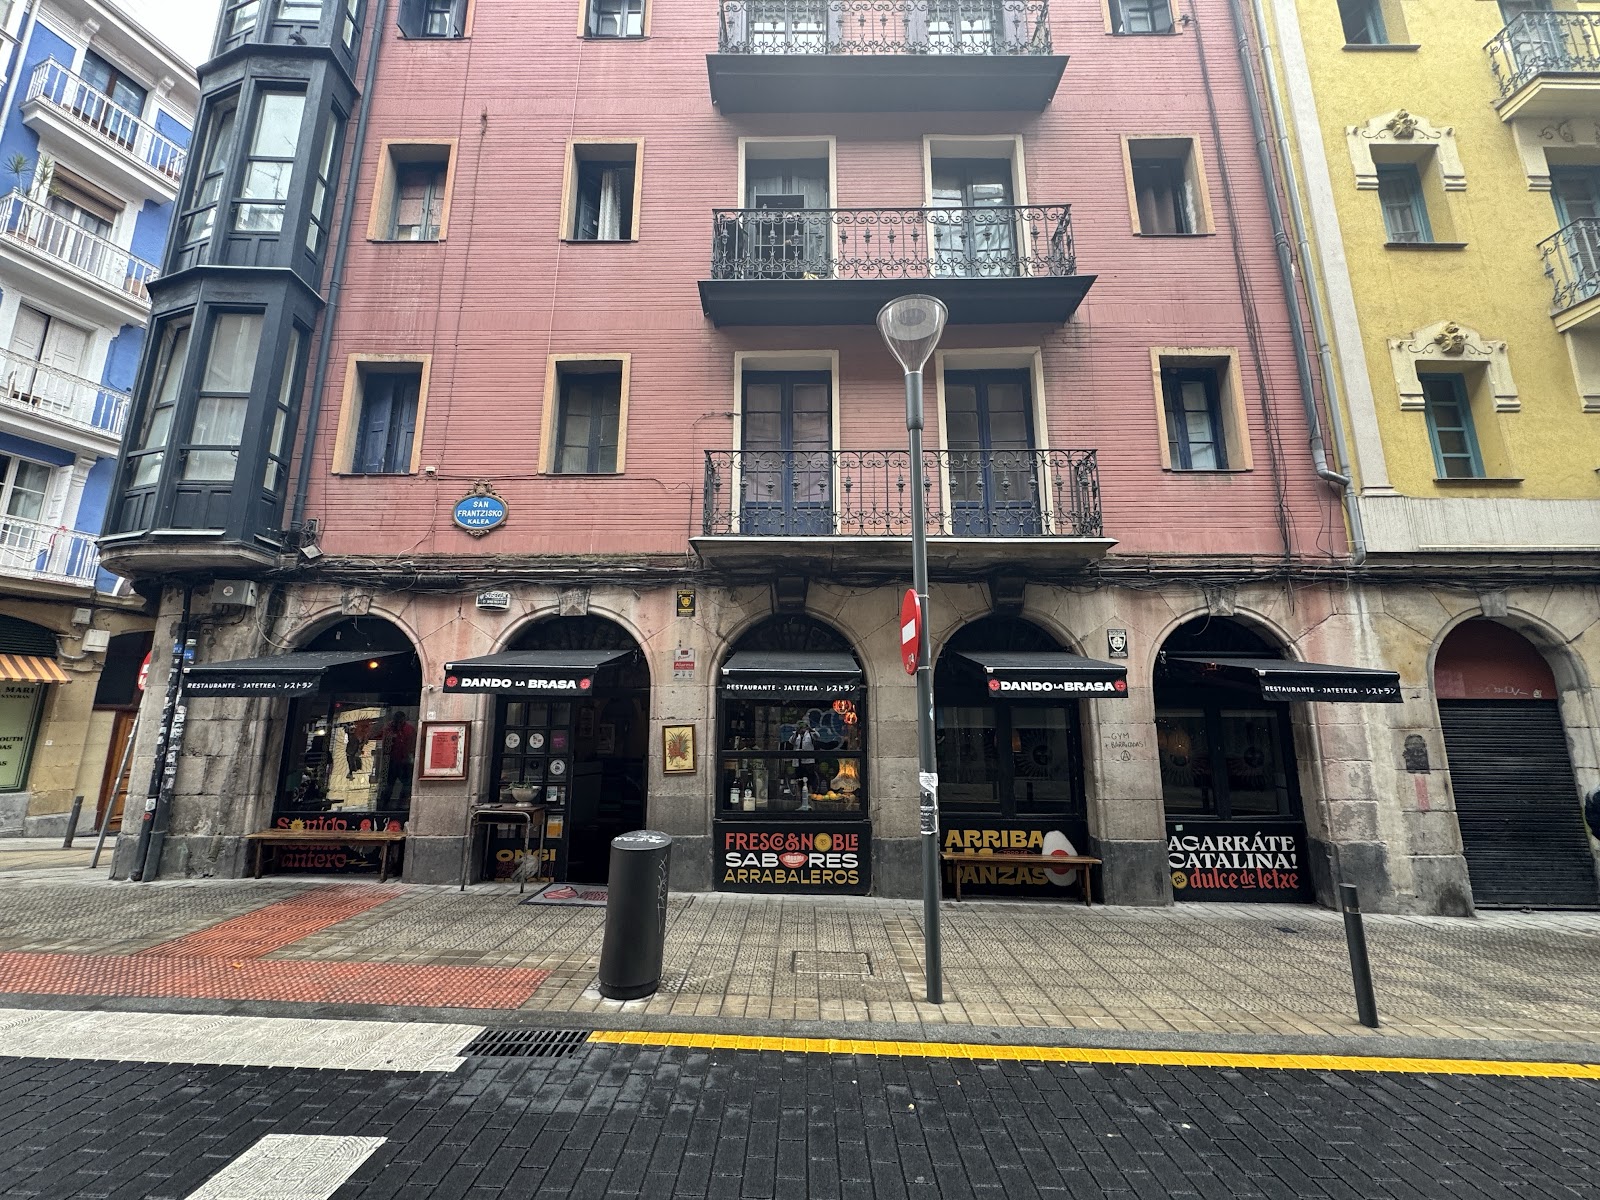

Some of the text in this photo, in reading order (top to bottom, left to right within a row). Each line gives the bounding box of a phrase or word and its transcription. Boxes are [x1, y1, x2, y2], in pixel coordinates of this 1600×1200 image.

[457, 510, 503, 518] FRANTZISKO
[461, 678, 512, 688] DANDO
[528, 679, 577, 689] BRASA
[1000, 681, 1053, 691] DANDO
[1064, 682, 1115, 692] BRASA
[1111, 732, 1130, 740] GYM
[944, 829, 1043, 848] ARRIBA
[1168, 831, 1296, 851] AGARRÁTE
[1168, 853, 1298, 869] CATALINA!
[723, 868, 859, 884] ARRABALEROS
[1190, 867, 1299, 889] dulce de letxe
